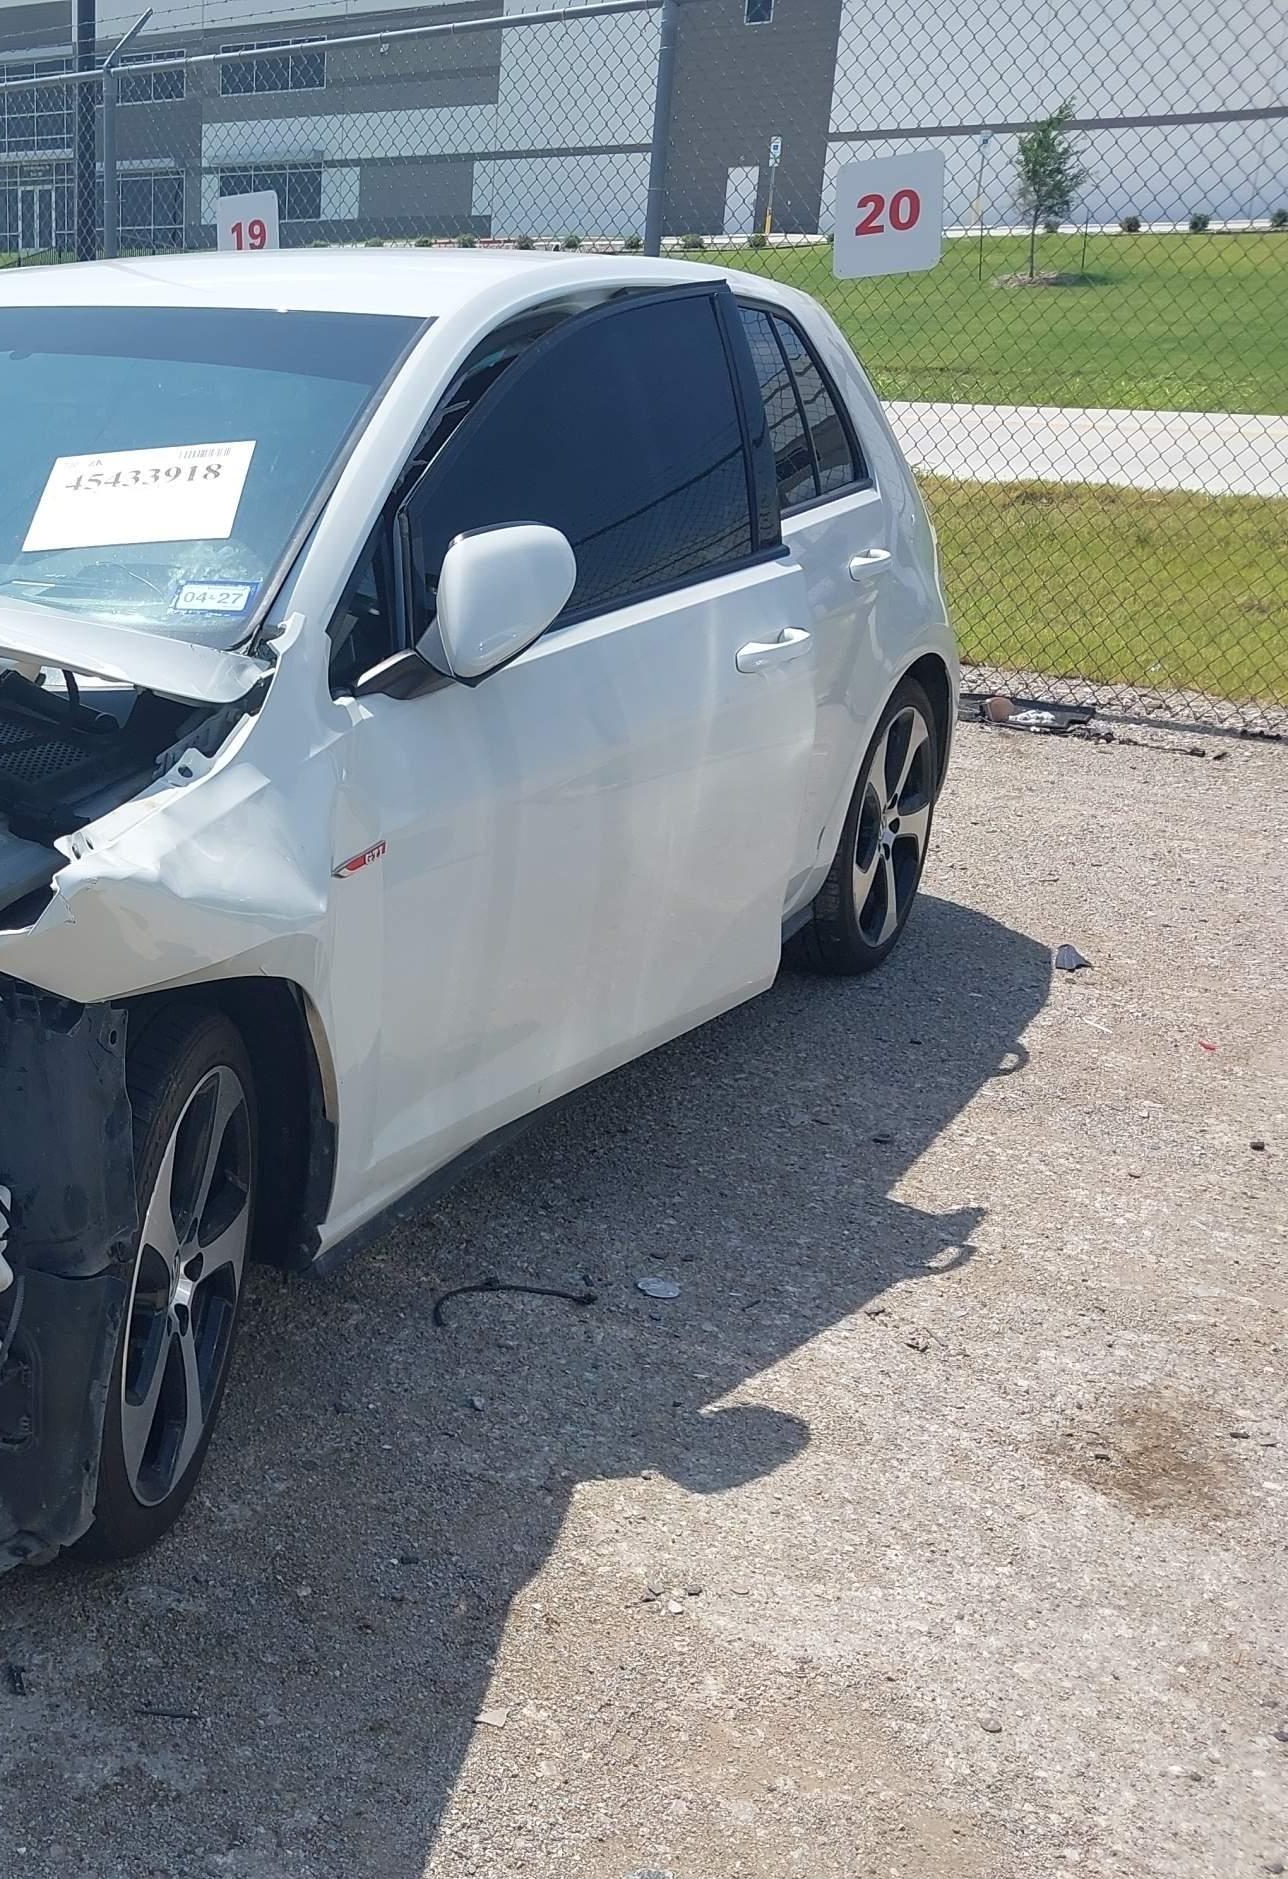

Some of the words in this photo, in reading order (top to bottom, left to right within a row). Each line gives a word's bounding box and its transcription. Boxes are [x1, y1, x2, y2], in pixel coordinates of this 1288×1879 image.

[855, 189, 920, 236] 20
[231, 219, 266, 250] 19
[64, 463, 223, 491] 45433918
